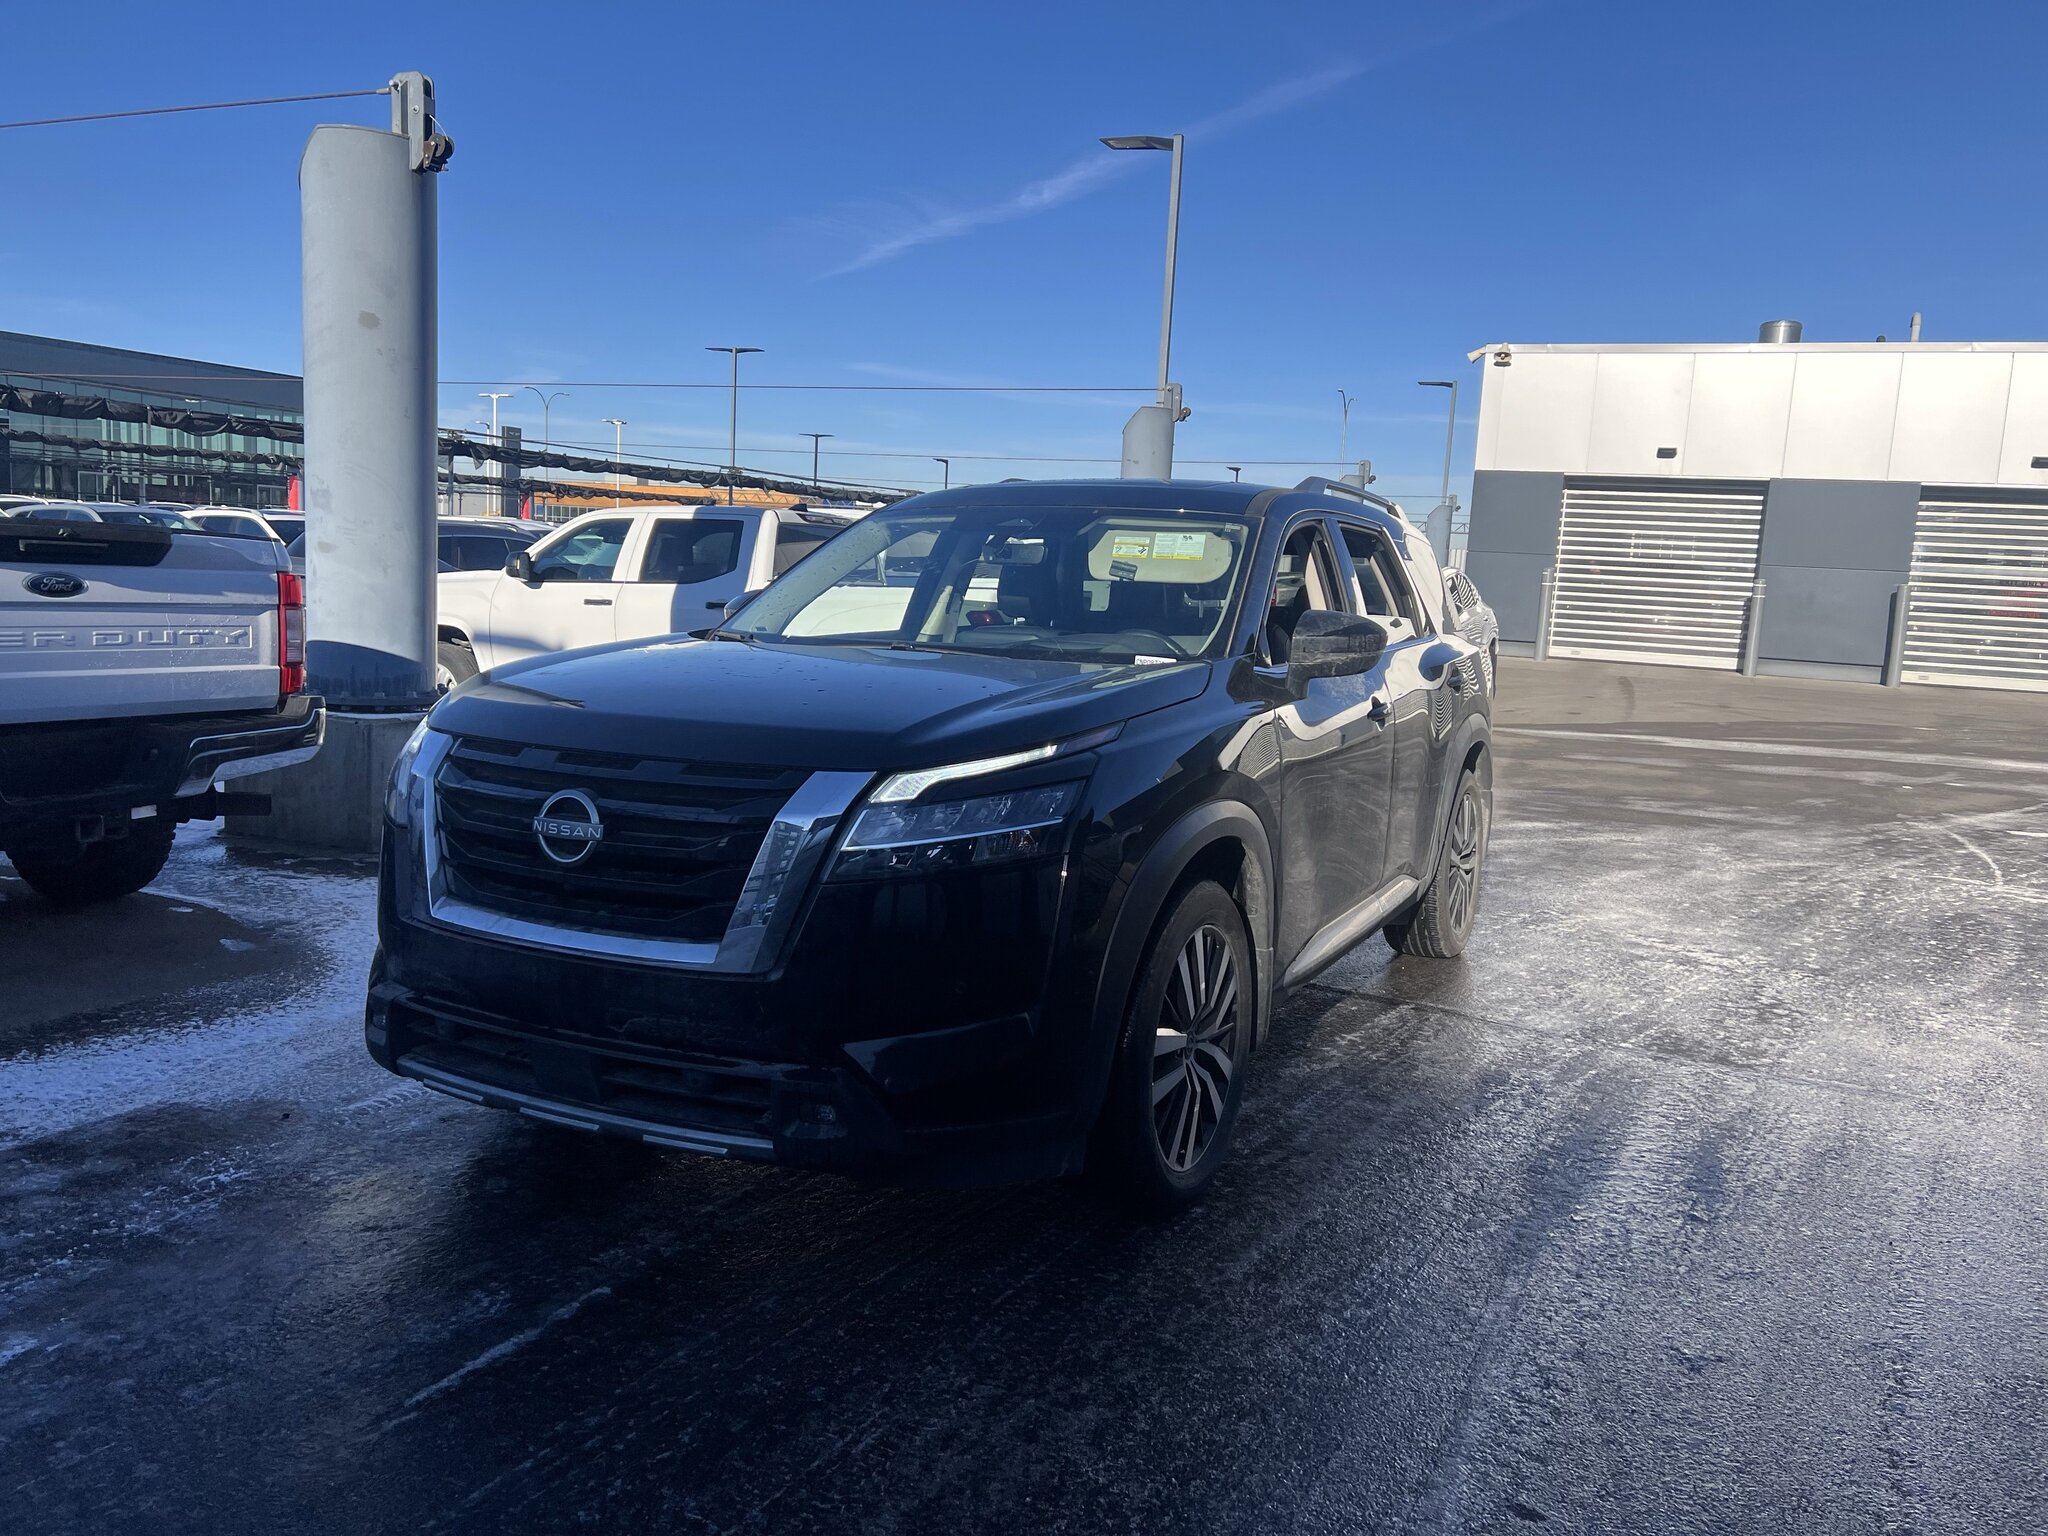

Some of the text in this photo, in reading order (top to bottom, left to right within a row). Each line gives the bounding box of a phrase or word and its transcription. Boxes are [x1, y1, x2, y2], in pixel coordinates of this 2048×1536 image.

[40, 576, 74, 592] Ford
[92, 629, 248, 647] DUTY
[533, 820, 601, 838] NISSAN
